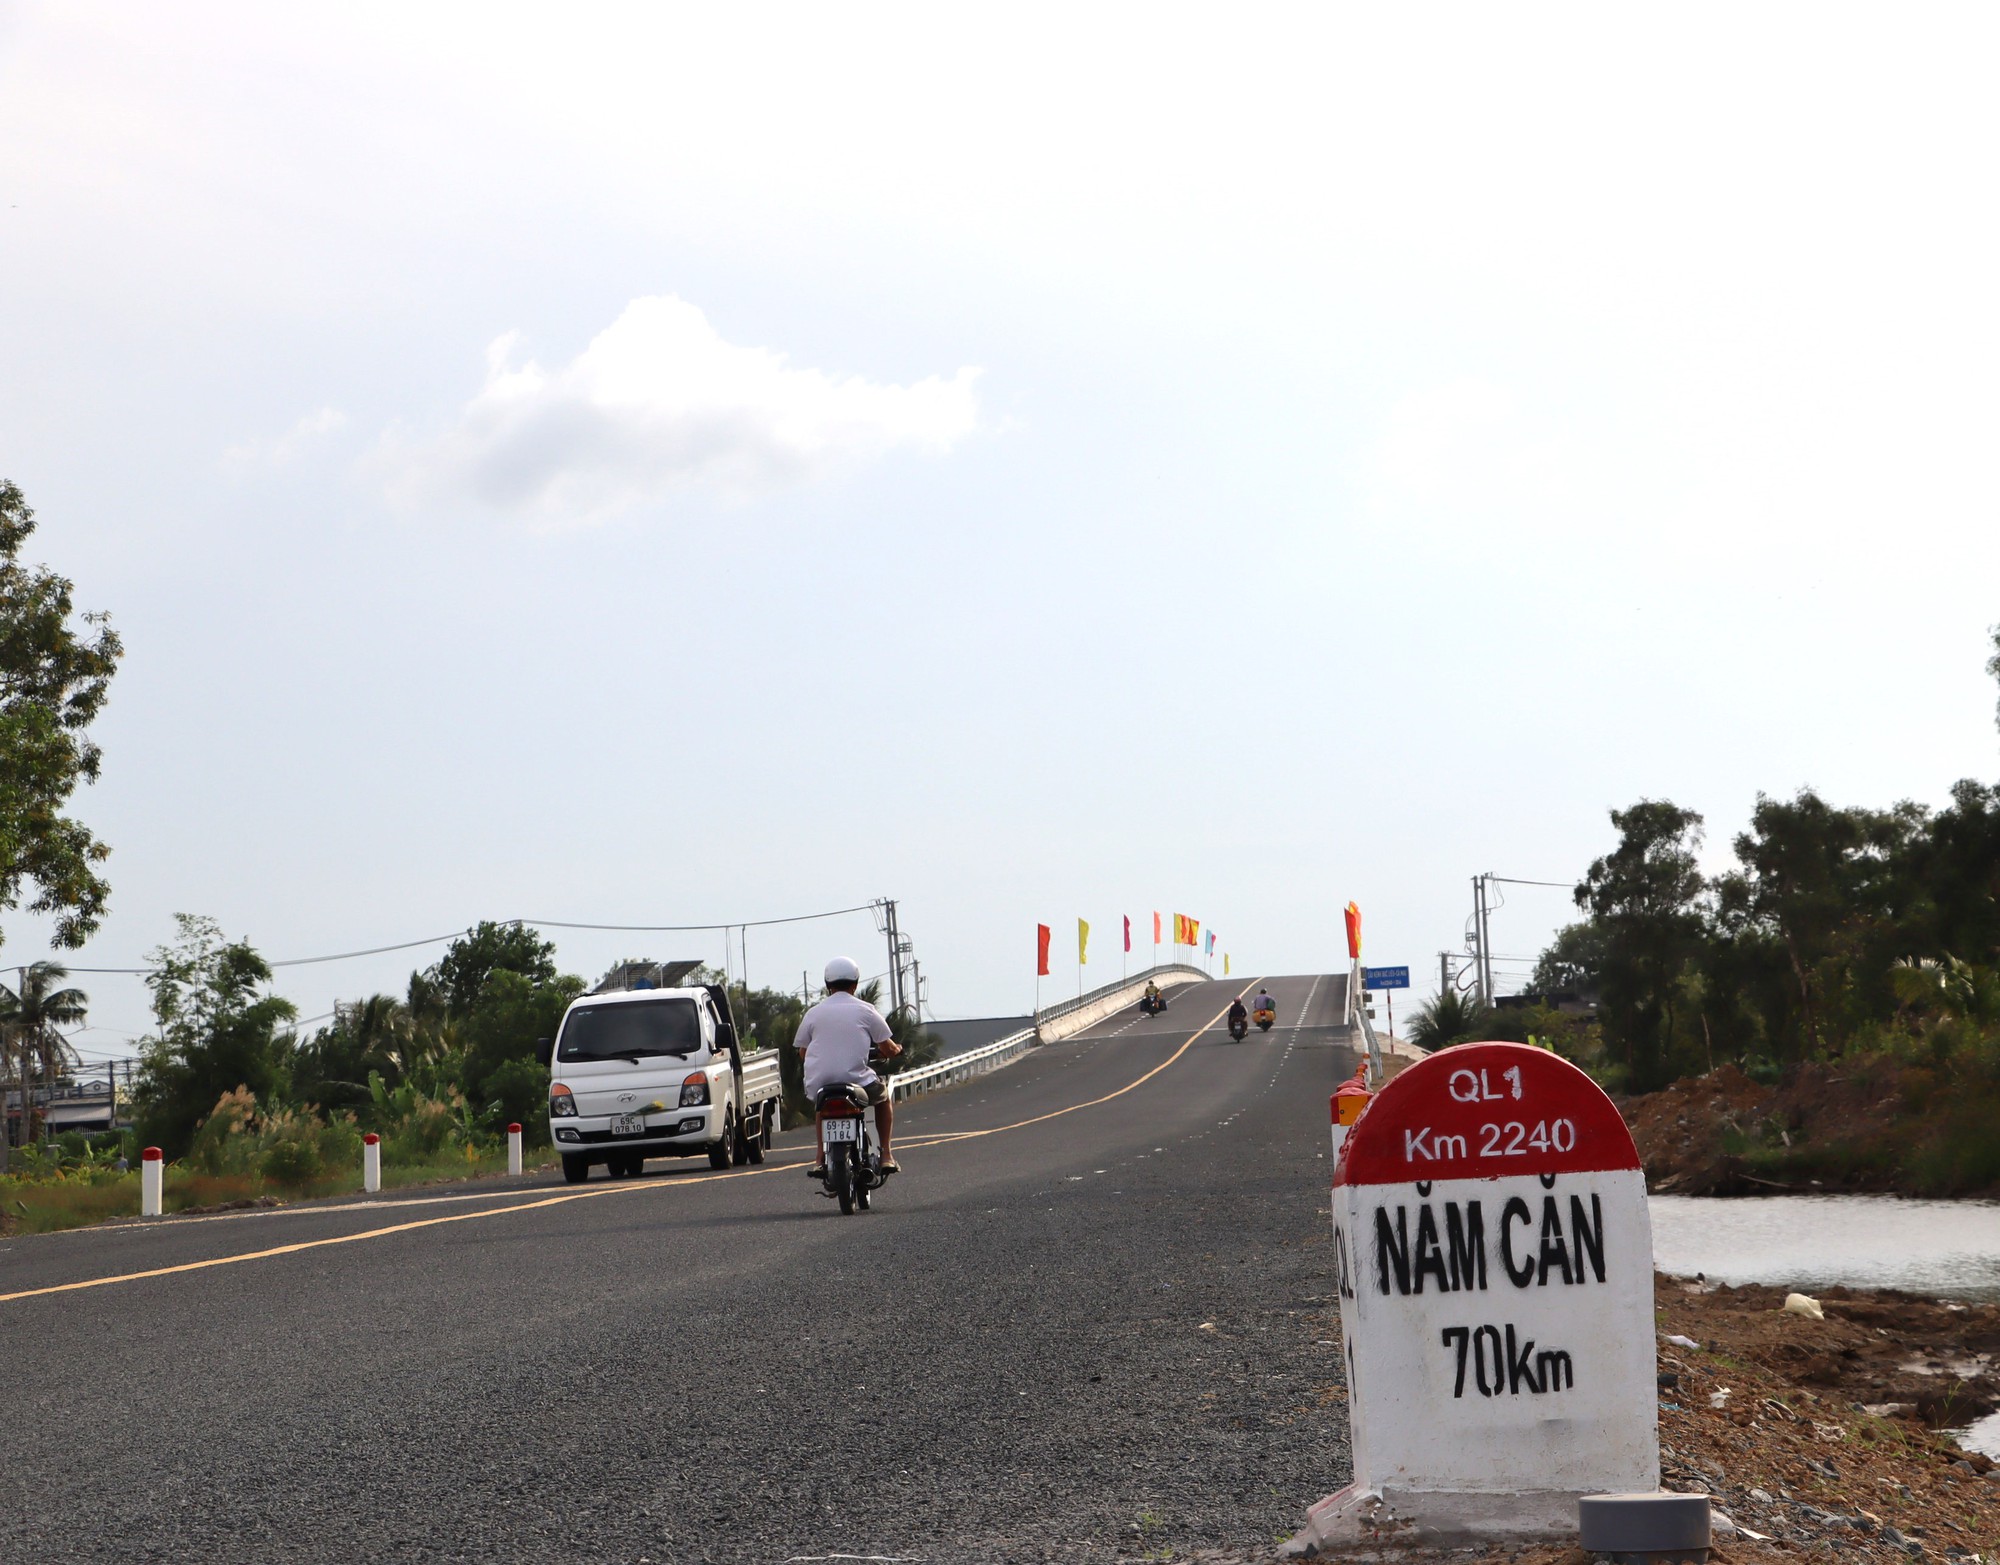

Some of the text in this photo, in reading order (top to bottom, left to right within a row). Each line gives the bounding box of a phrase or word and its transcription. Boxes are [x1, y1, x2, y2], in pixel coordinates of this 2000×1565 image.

[1449, 1065, 1523, 1103] QL1
[620, 1116, 635, 1125] 69C
[827, 1130, 851, 1140] 1184
[1404, 1118, 1575, 1163] Km 2240
[1375, 1172, 1607, 1295] NĂM CĂN
[1442, 1323, 1574, 1399] 70km
